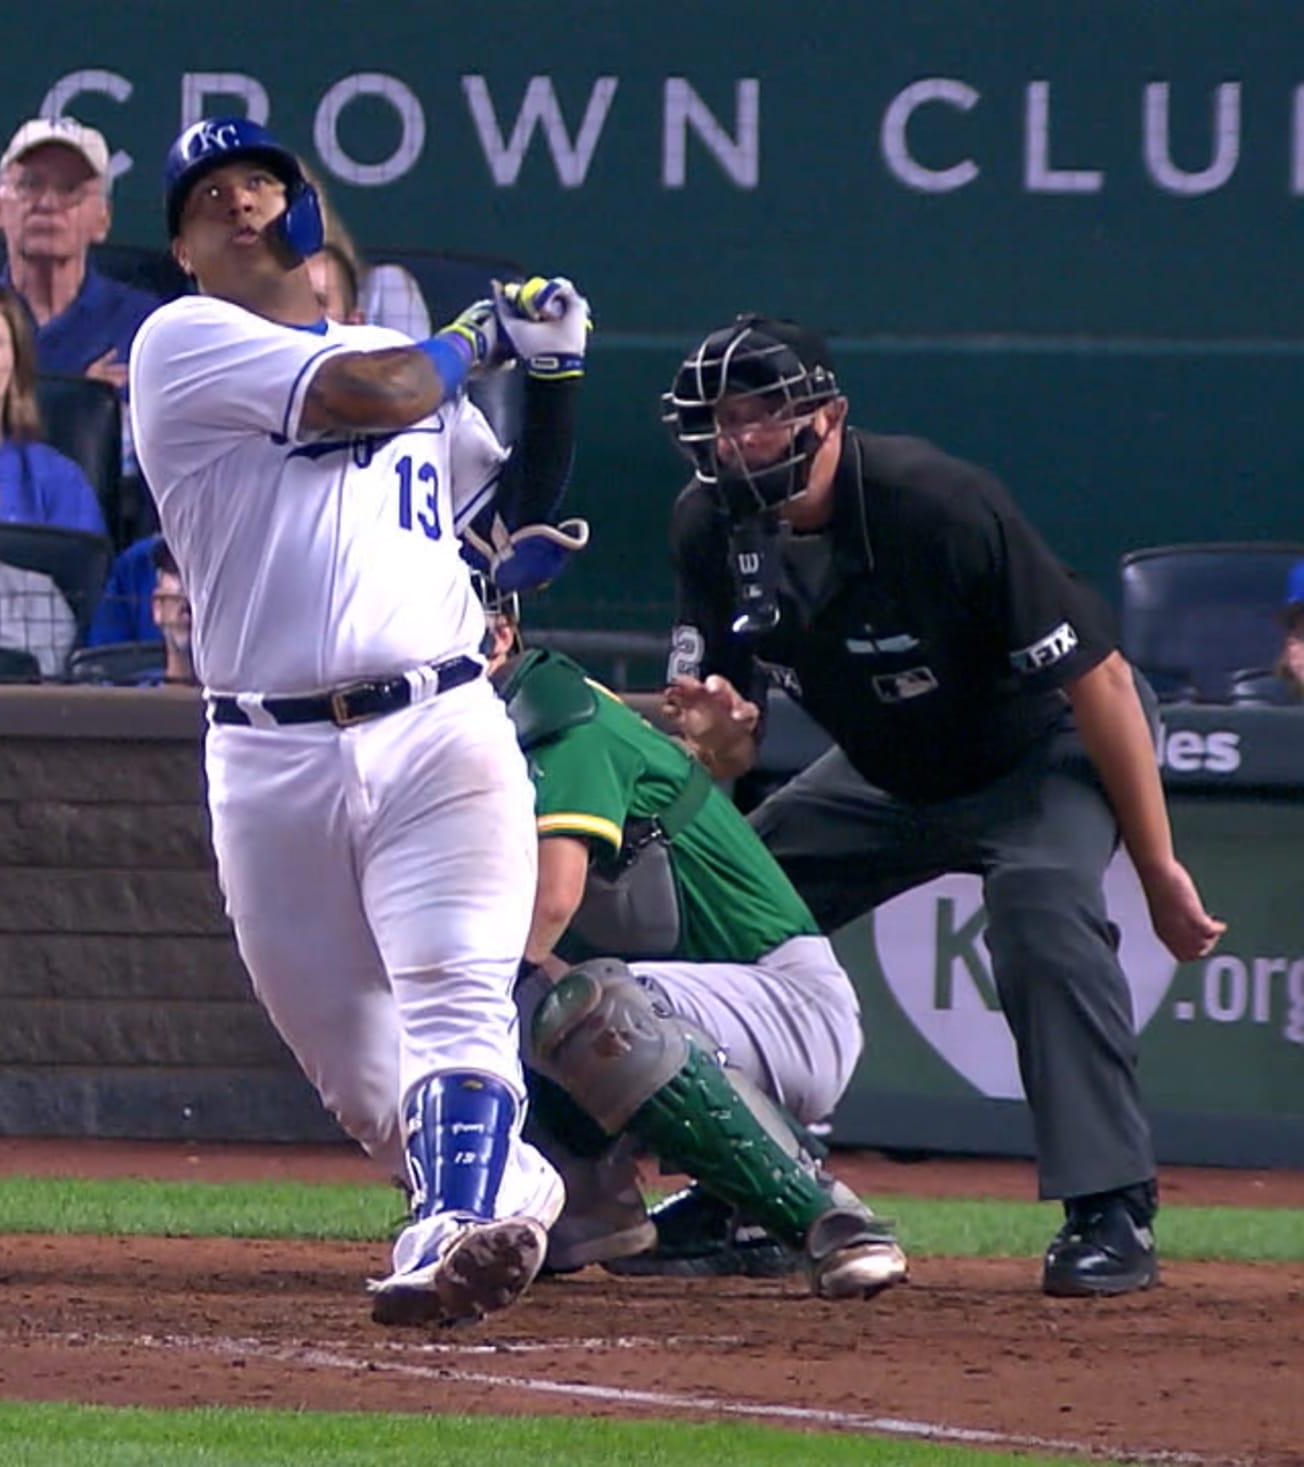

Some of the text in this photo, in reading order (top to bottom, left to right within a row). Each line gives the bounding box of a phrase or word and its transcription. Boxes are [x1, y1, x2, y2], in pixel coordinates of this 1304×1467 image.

[881, 78, 1304, 196] CLU
[395, 455, 442, 541] 13
[1030, 622, 1079, 668] FTX
